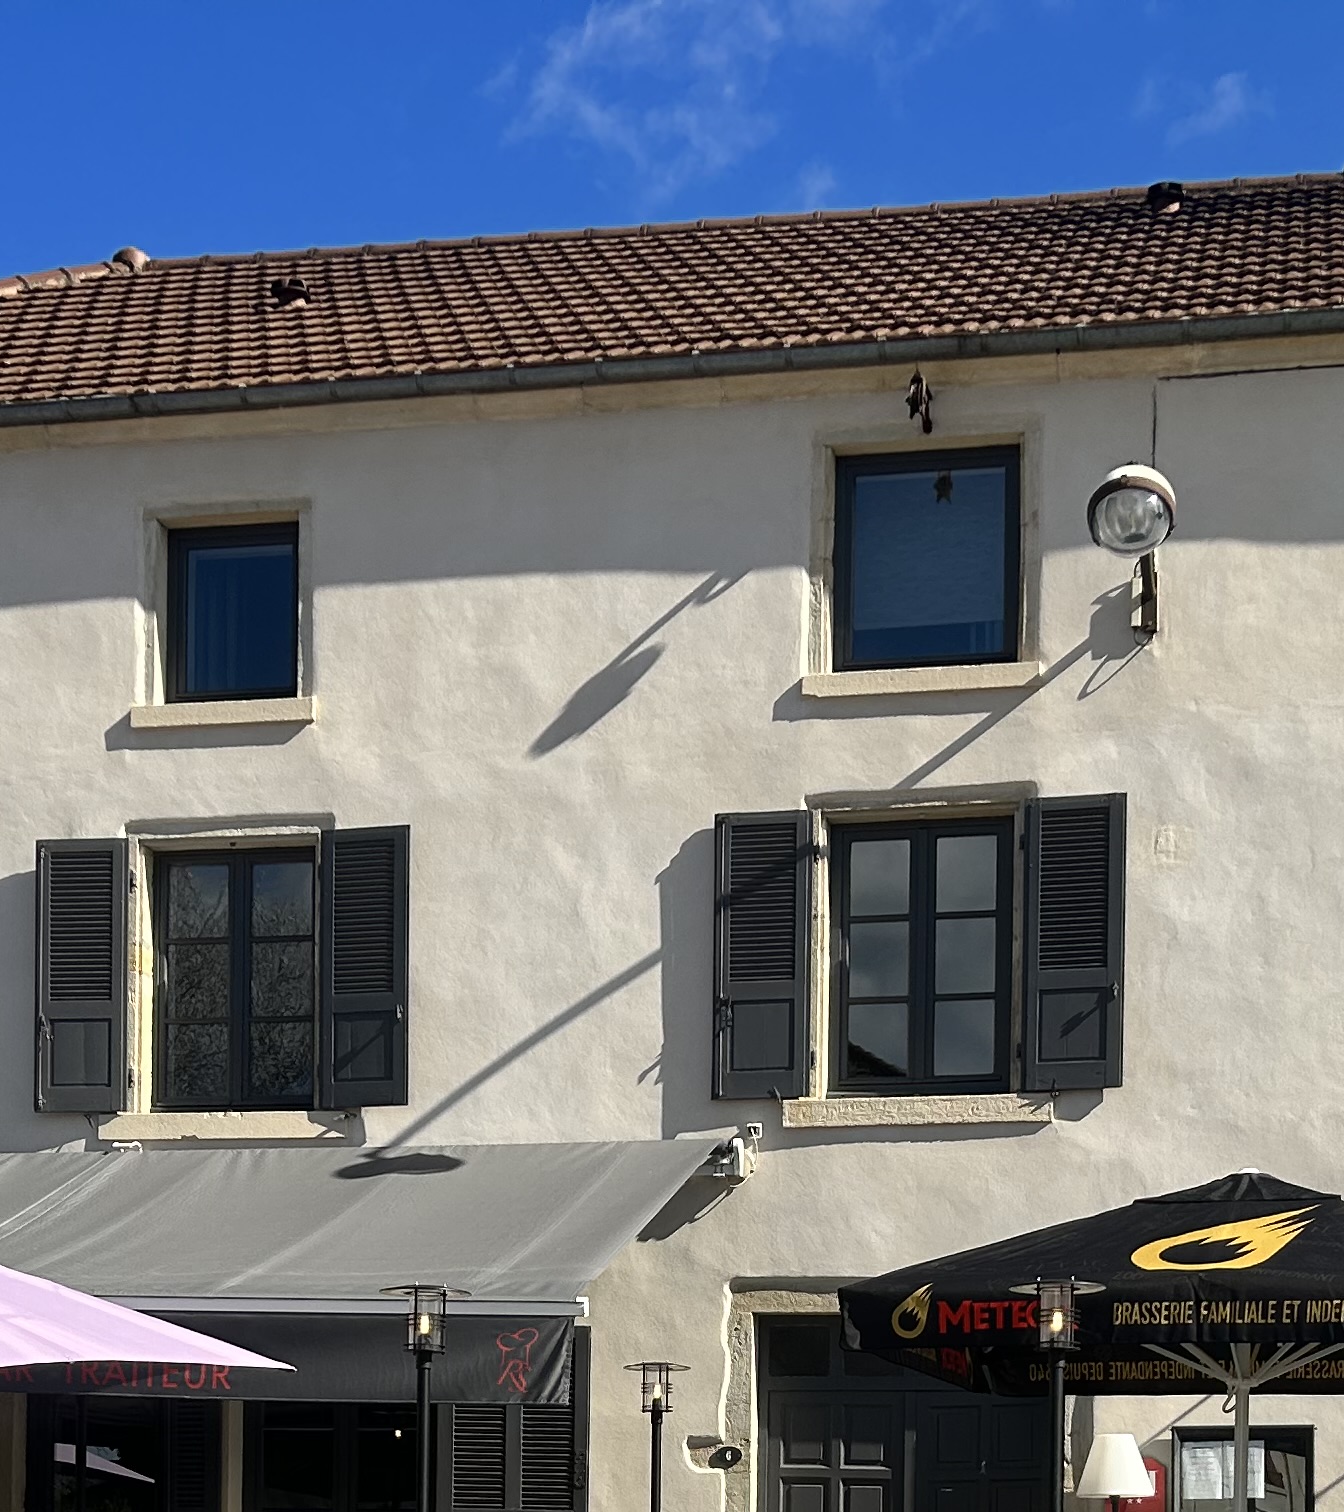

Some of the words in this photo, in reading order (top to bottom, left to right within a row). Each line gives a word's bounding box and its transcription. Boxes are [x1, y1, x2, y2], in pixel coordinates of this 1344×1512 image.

[937, 1299, 1079, 1334] METE
[1113, 1301, 1194, 1325] BRASSERIE
[1199, 1300, 1277, 1324] FAMILIALE
[1282, 1300, 1302, 1324] ET
